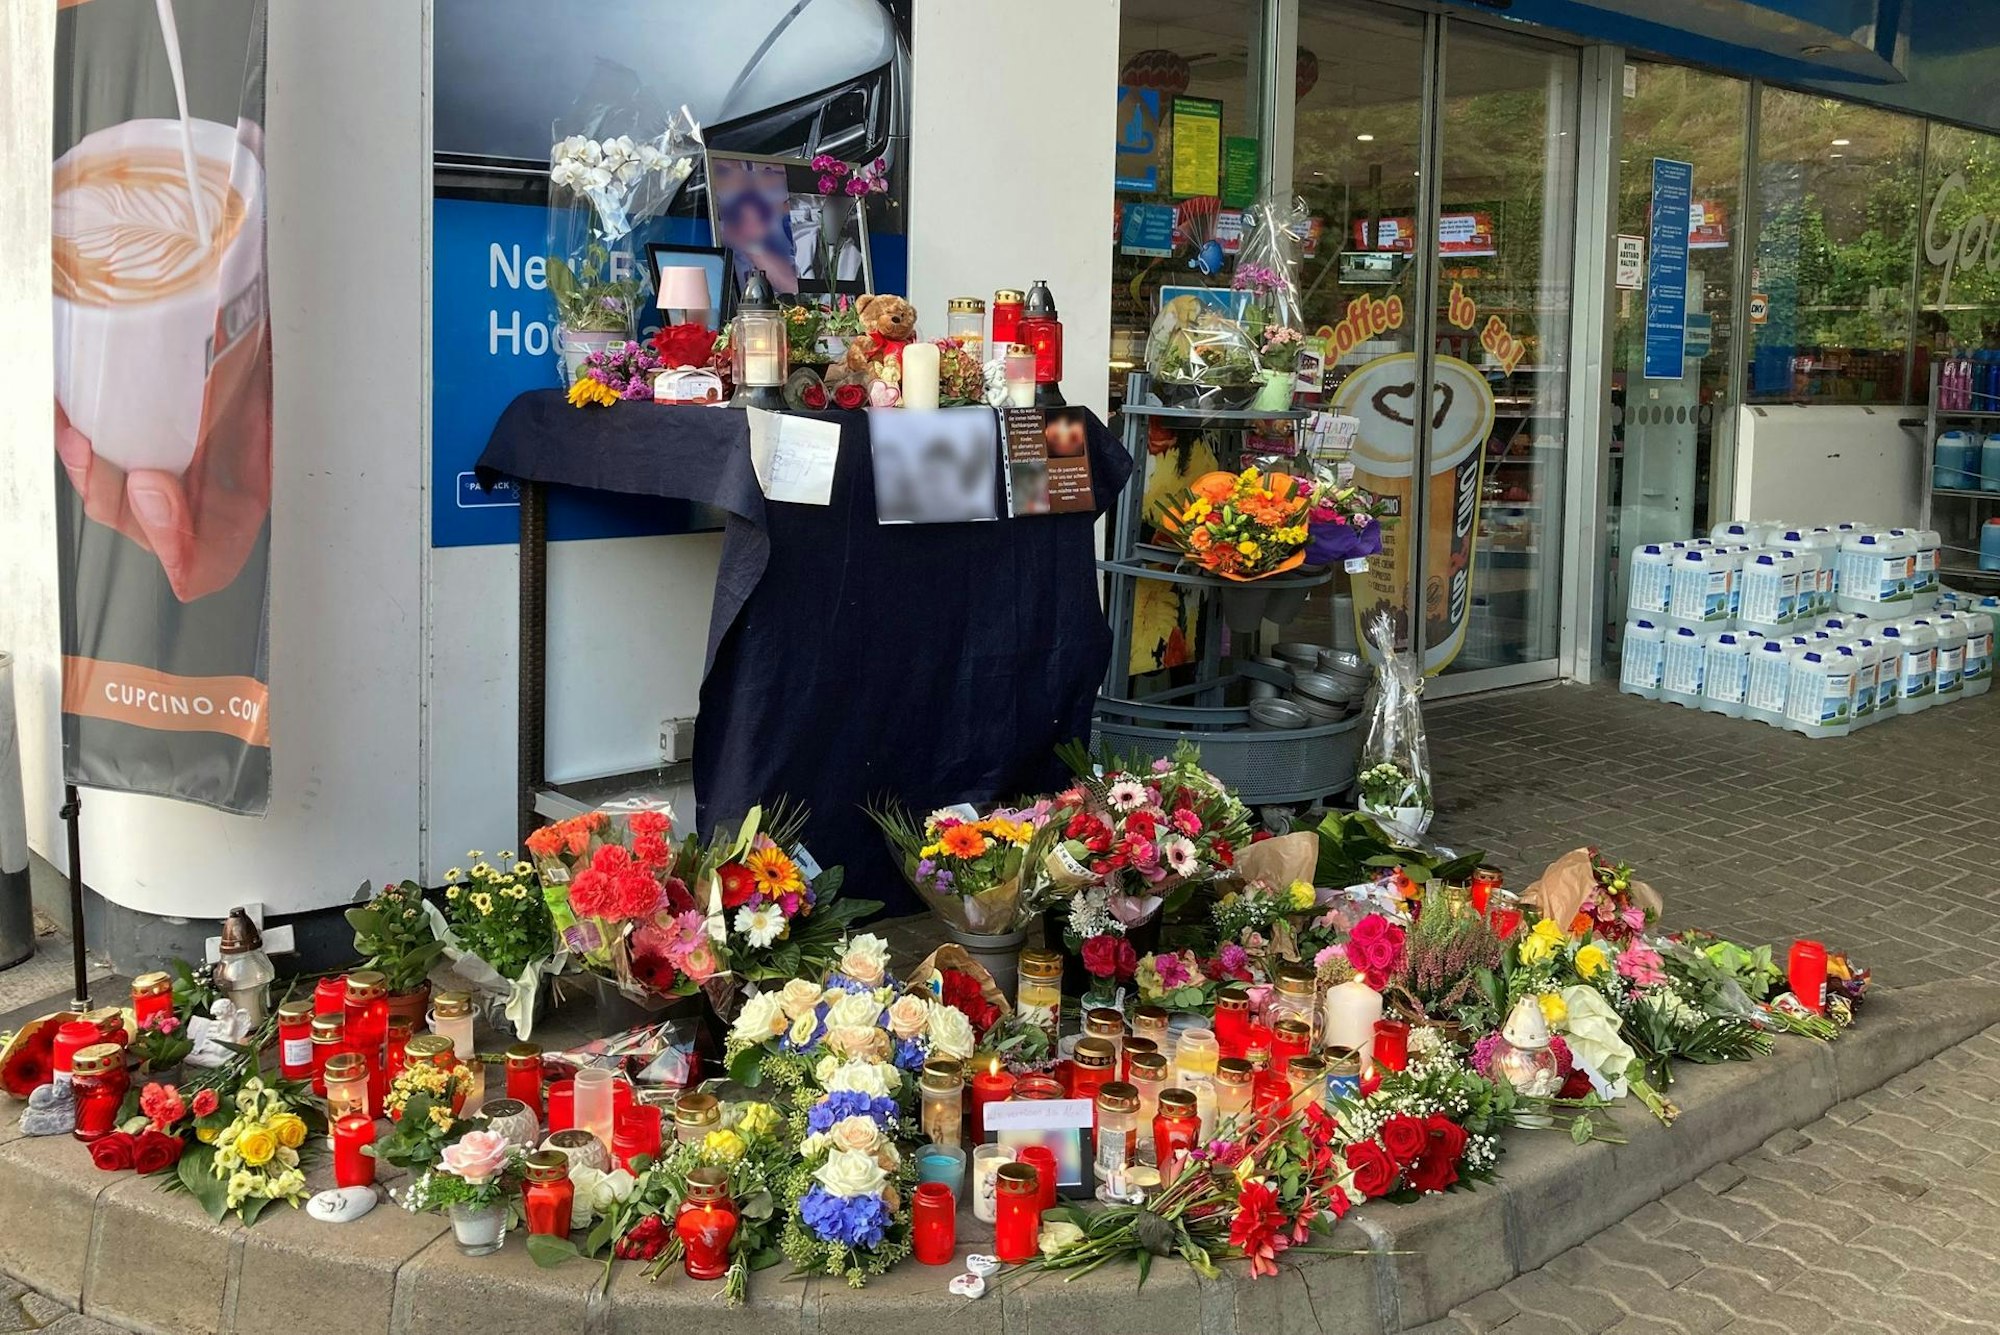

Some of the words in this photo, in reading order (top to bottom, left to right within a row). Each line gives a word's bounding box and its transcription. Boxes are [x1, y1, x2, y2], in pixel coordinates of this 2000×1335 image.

[1449, 283, 1476, 330] to
[1480, 315, 1526, 377] go!
[469, 482, 510, 491] PAACK
[1456, 460, 1477, 538] CINO
[1451, 568, 1467, 624] CUP
